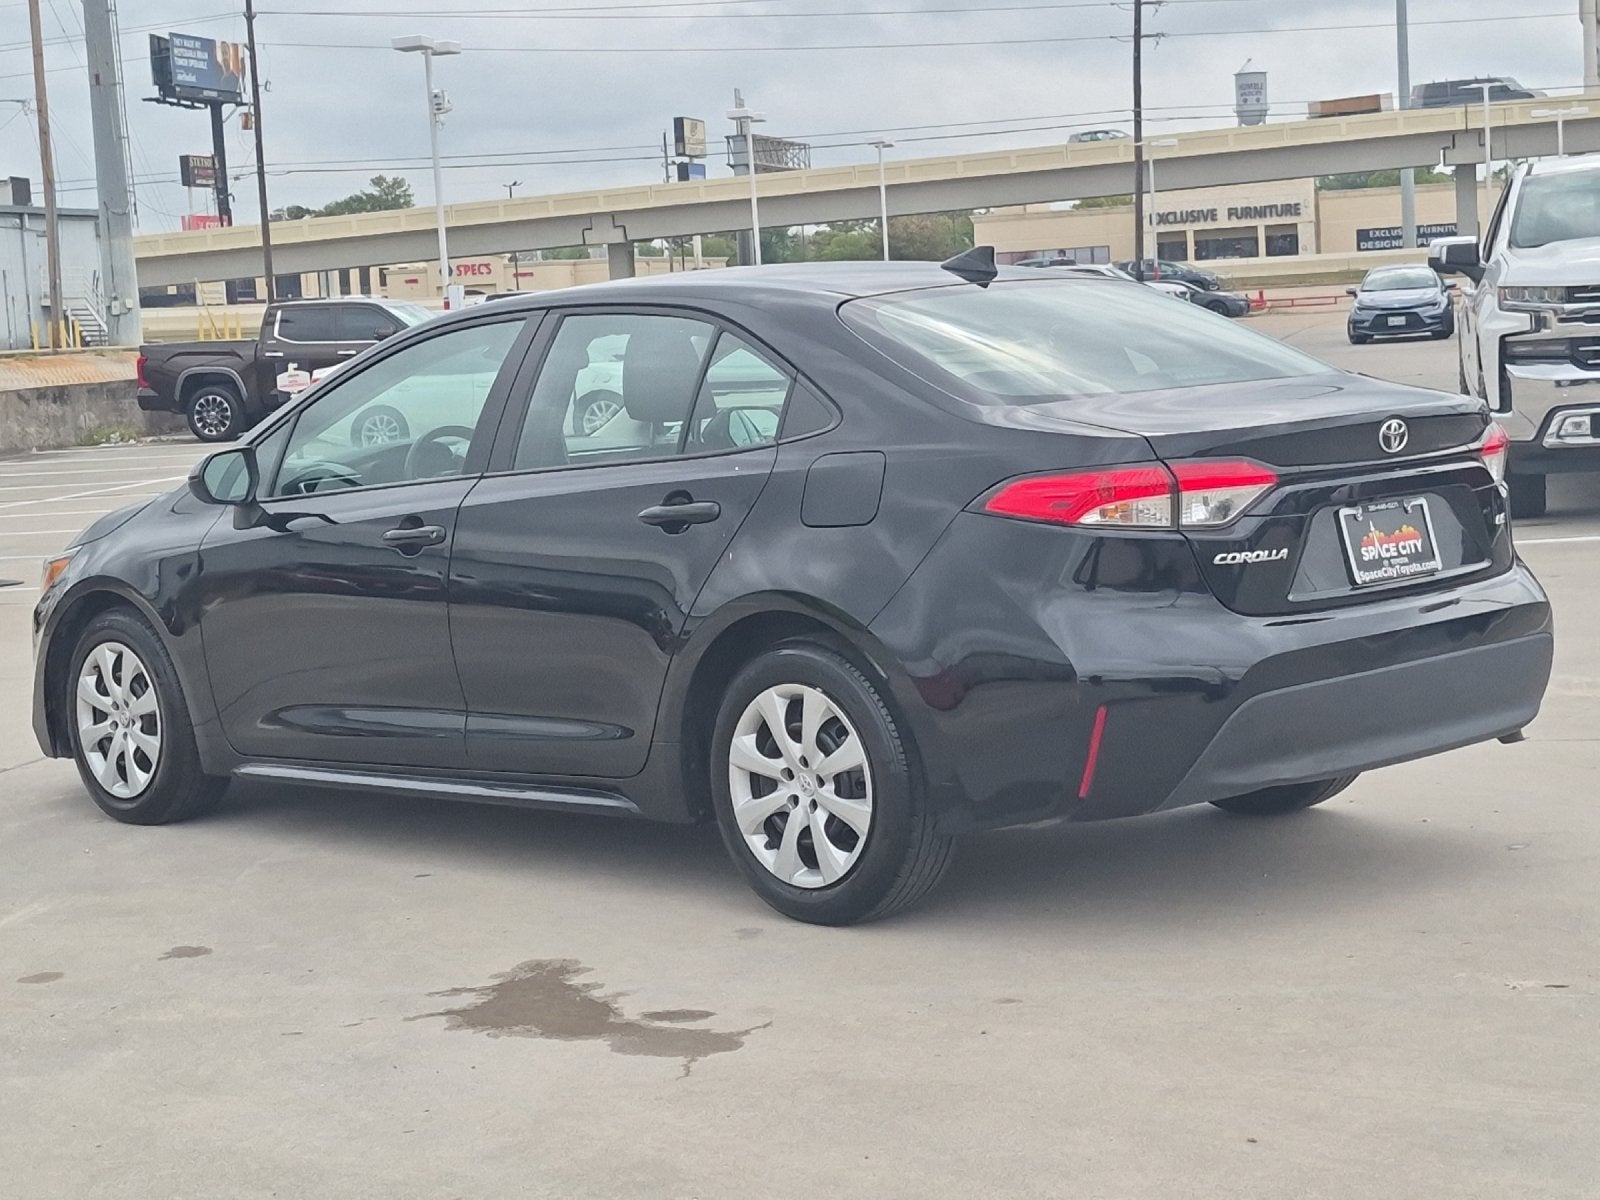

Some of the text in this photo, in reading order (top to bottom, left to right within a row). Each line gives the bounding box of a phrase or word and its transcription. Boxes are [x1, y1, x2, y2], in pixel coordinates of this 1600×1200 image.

[1227, 203, 1301, 220] FURNITURE
[1369, 225, 1457, 238] EXCLUS FURNITU
[1360, 239, 1404, 249] DESIGNE
[1213, 547, 1289, 565] COROLLA
[1361, 538, 1422, 561] SPACE CITY
[1360, 561, 1437, 581] SpaceCityToyota.com
